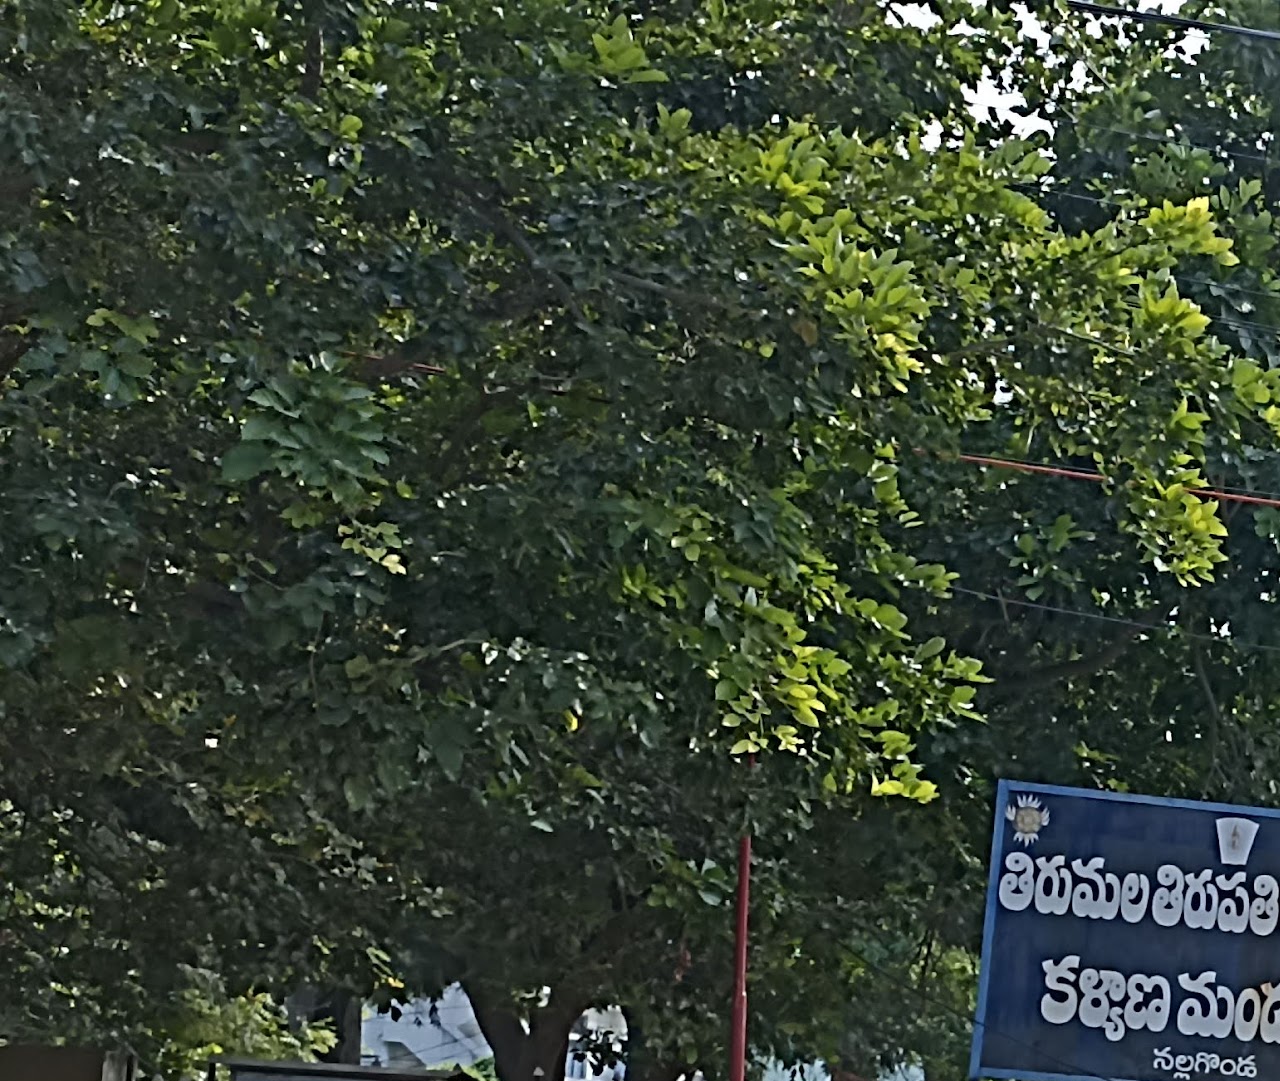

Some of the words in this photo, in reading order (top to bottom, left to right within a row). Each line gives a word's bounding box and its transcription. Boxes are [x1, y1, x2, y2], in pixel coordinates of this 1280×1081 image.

[999, 851, 1150, 923] తిరుమల
[1152, 864, 1280, 936] తిరుపతి
[1040, 954, 1172, 1041] కళ్యాణ
[1152, 1046, 1258, 1080] నల్లగొండ
